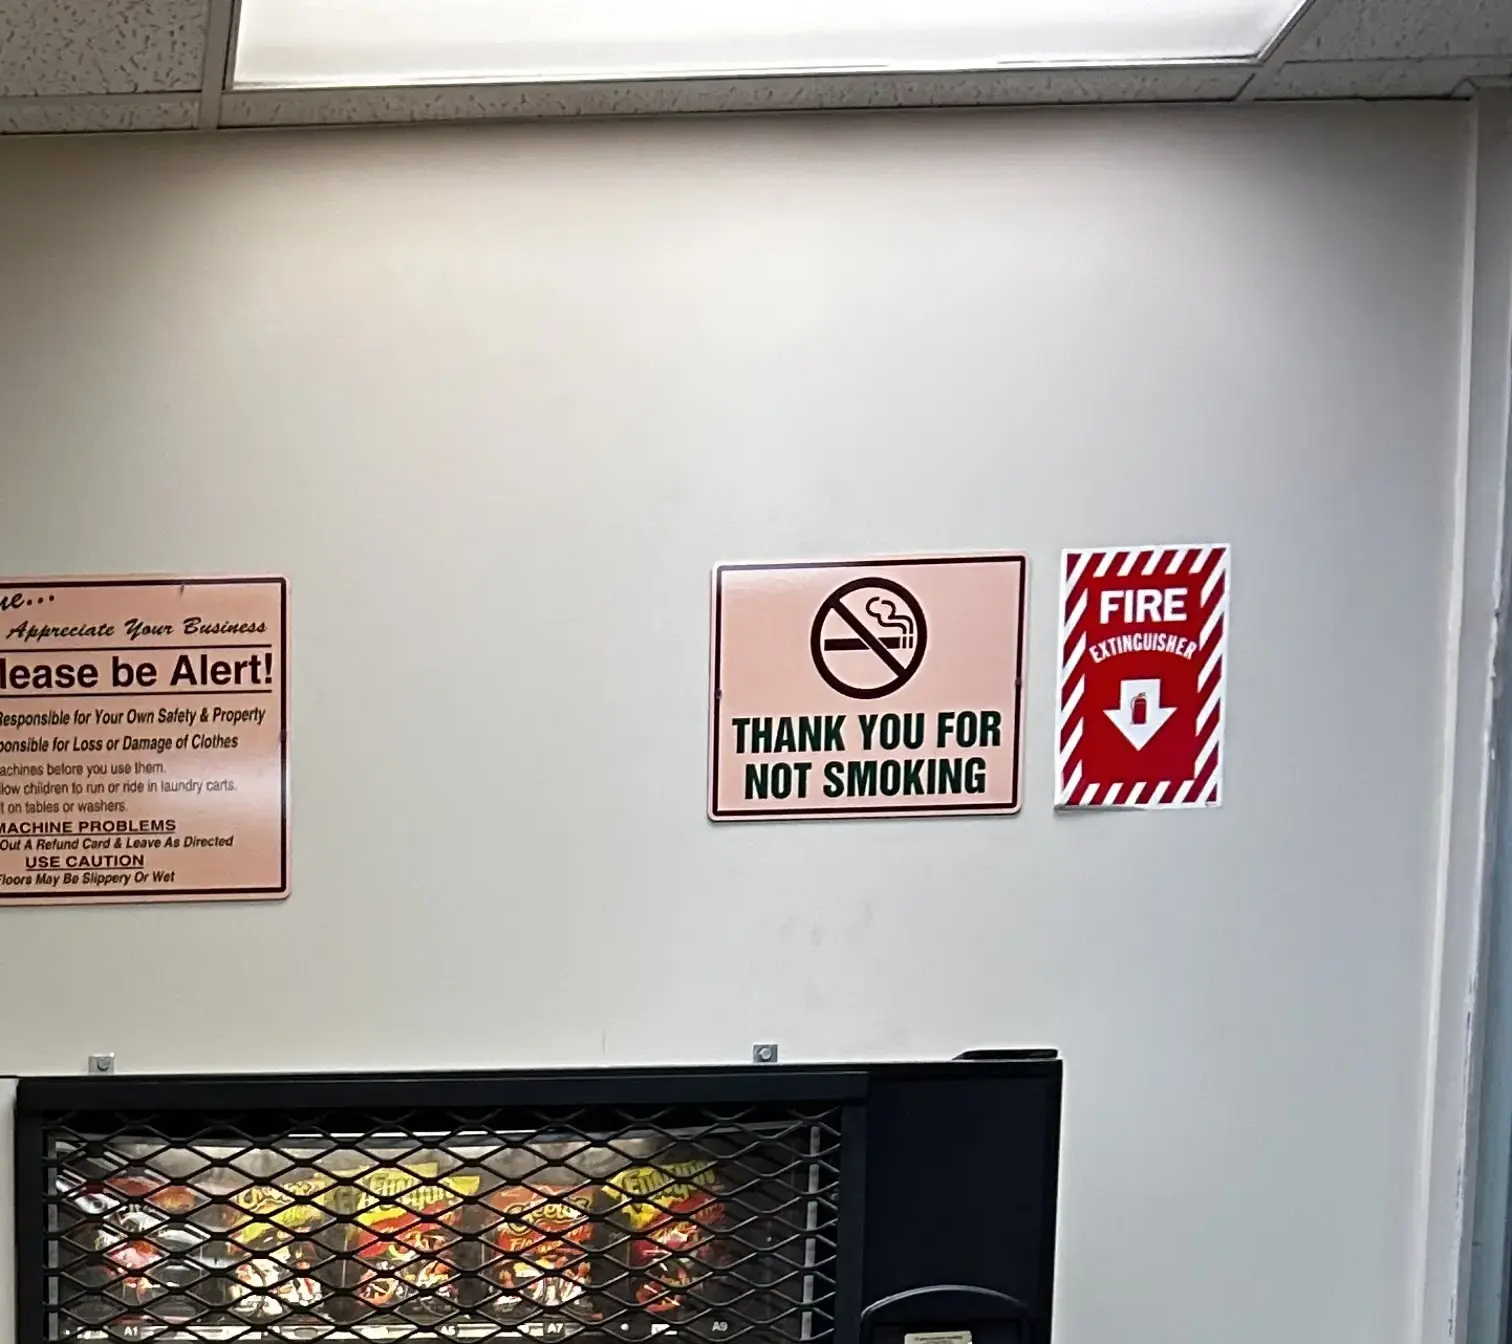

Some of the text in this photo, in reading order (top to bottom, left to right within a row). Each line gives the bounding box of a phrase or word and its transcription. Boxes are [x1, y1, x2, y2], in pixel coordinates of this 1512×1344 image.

[1100, 587, 1186, 624] FIRE
[6, 620, 115, 642] Appreciate
[124, 618, 174, 641] Your
[183, 616, 267, 635] Business
[1088, 632, 1197, 664] EXTINGUISHER
[112, 656, 157, 687] be
[170, 652, 272, 686] Alert!
[74, 710, 91, 725] for
[95, 708, 124, 725] Your
[126, 708, 154, 724] Own
[158, 707, 196, 727] Safety
[200, 707, 208, 722] &
[212, 707, 266, 726] Property
[732, 710, 1001, 754] THANK YOU FOR
[52, 737, 70, 751] for
[73, 736, 103, 752] Loss
[106, 740, 120, 750] or
[122, 736, 172, 753] Damage
[176, 734, 189, 749] of
[192, 734, 239, 749] Clothes
[47, 763, 84, 776] before
[87, 765, 108, 778] you
[110, 764, 131, 774] use
[134, 762, 166, 774] them.
[744, 757, 986, 800] NOT SMOKING
[24, 782, 68, 794] children
[72, 782, 83, 794] to
[86, 783, 104, 794] run
[108, 783, 120, 793] or
[123, 780, 144, 793] ride
[148, 780, 158, 792] in
[161, 779, 203, 794] laundry
[206, 779, 237, 792] carts.
[8, 804, 22, 814] on
[26, 800, 60, 813] tables
[63, 802, 75, 812] or
[78, 800, 128, 812] washers.
[79, 820, 176, 832] PROBLEMS
[0, 840, 21, 850] Out
[24, 840, 32, 850] A
[36, 838, 79, 850] Refund
[82, 838, 110, 849] Card
[114, 838, 122, 848] &
[126, 837, 161, 848] Leave
[164, 837, 180, 848] As
[184, 836, 234, 847] Directed
[26, 854, 144, 868] USE CAUTION
[36, 874, 60, 886] May
[63, 873, 79, 884] Be
[82, 872, 130, 886] Slippery
[134, 872, 148, 882] Or
[152, 871, 175, 882] Wet
[548, 1323, 563, 1336] A7
